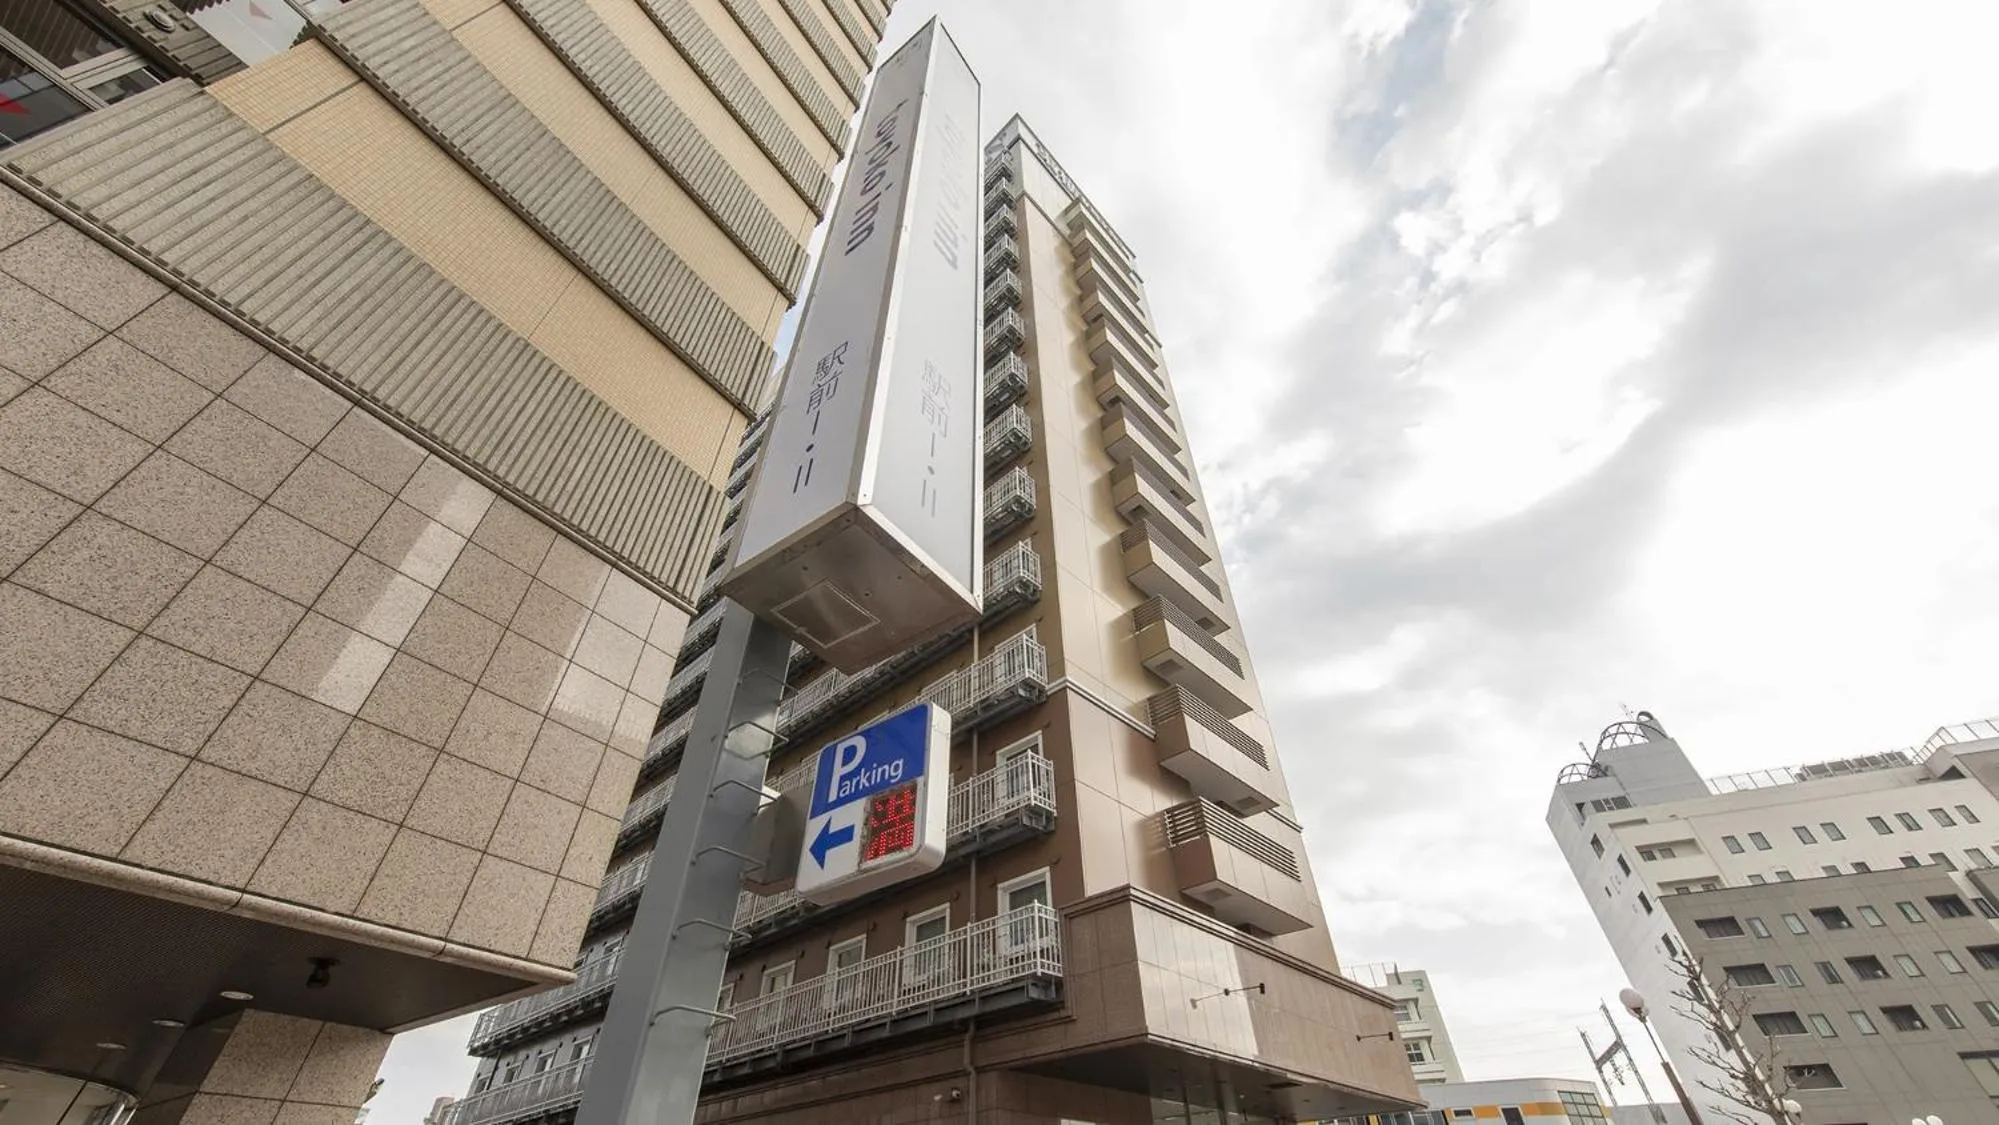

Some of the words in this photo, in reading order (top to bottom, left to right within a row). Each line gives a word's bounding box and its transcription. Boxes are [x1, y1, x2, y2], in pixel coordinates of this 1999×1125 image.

[860, 97, 910, 196] toyoko
[844, 182, 896, 257] inn
[827, 735, 904, 803] Parking
